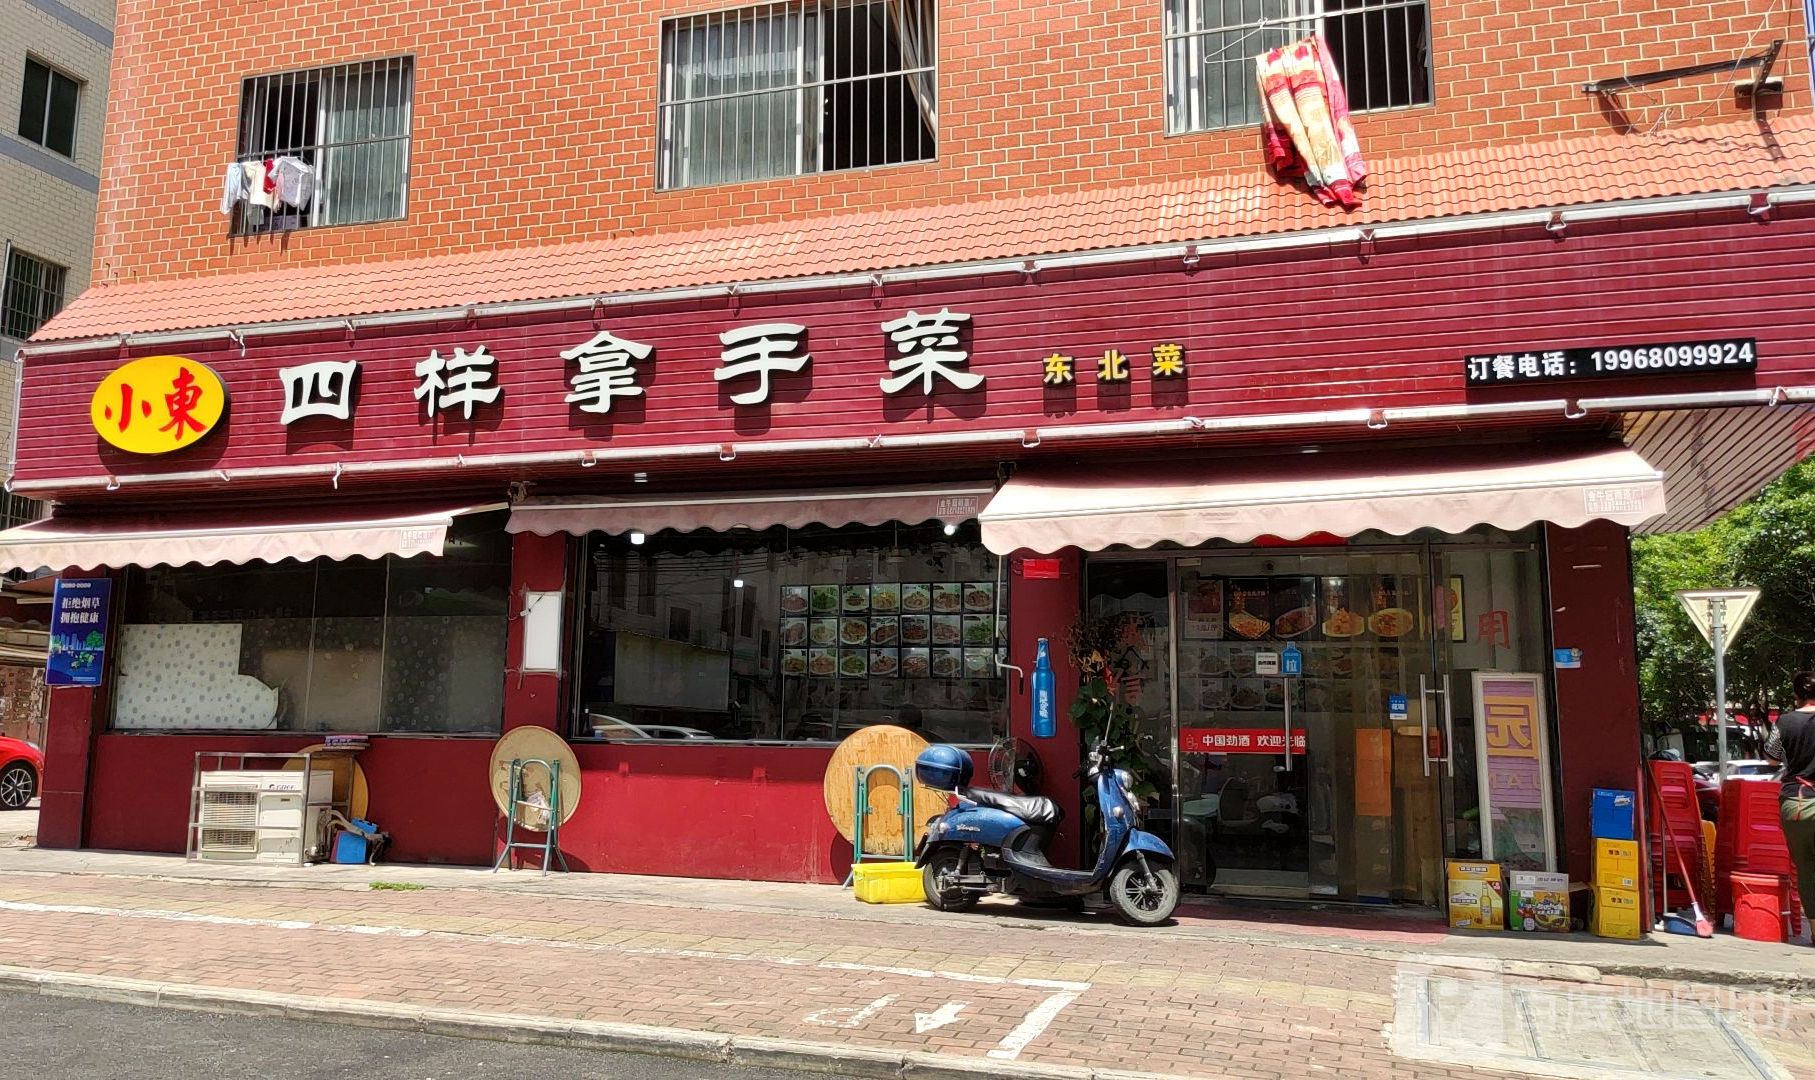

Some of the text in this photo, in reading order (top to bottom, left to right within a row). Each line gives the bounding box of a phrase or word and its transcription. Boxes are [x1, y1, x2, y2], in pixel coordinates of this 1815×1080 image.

[279, 307, 984, 425] 四样拿手菜
[1043, 342, 1187, 385] 东北菜
[61, 596, 101, 609] 拒绝烟草
[60, 611, 100, 624] 拥抱健康
[1202, 734, 1250, 747] 中国劲酒
